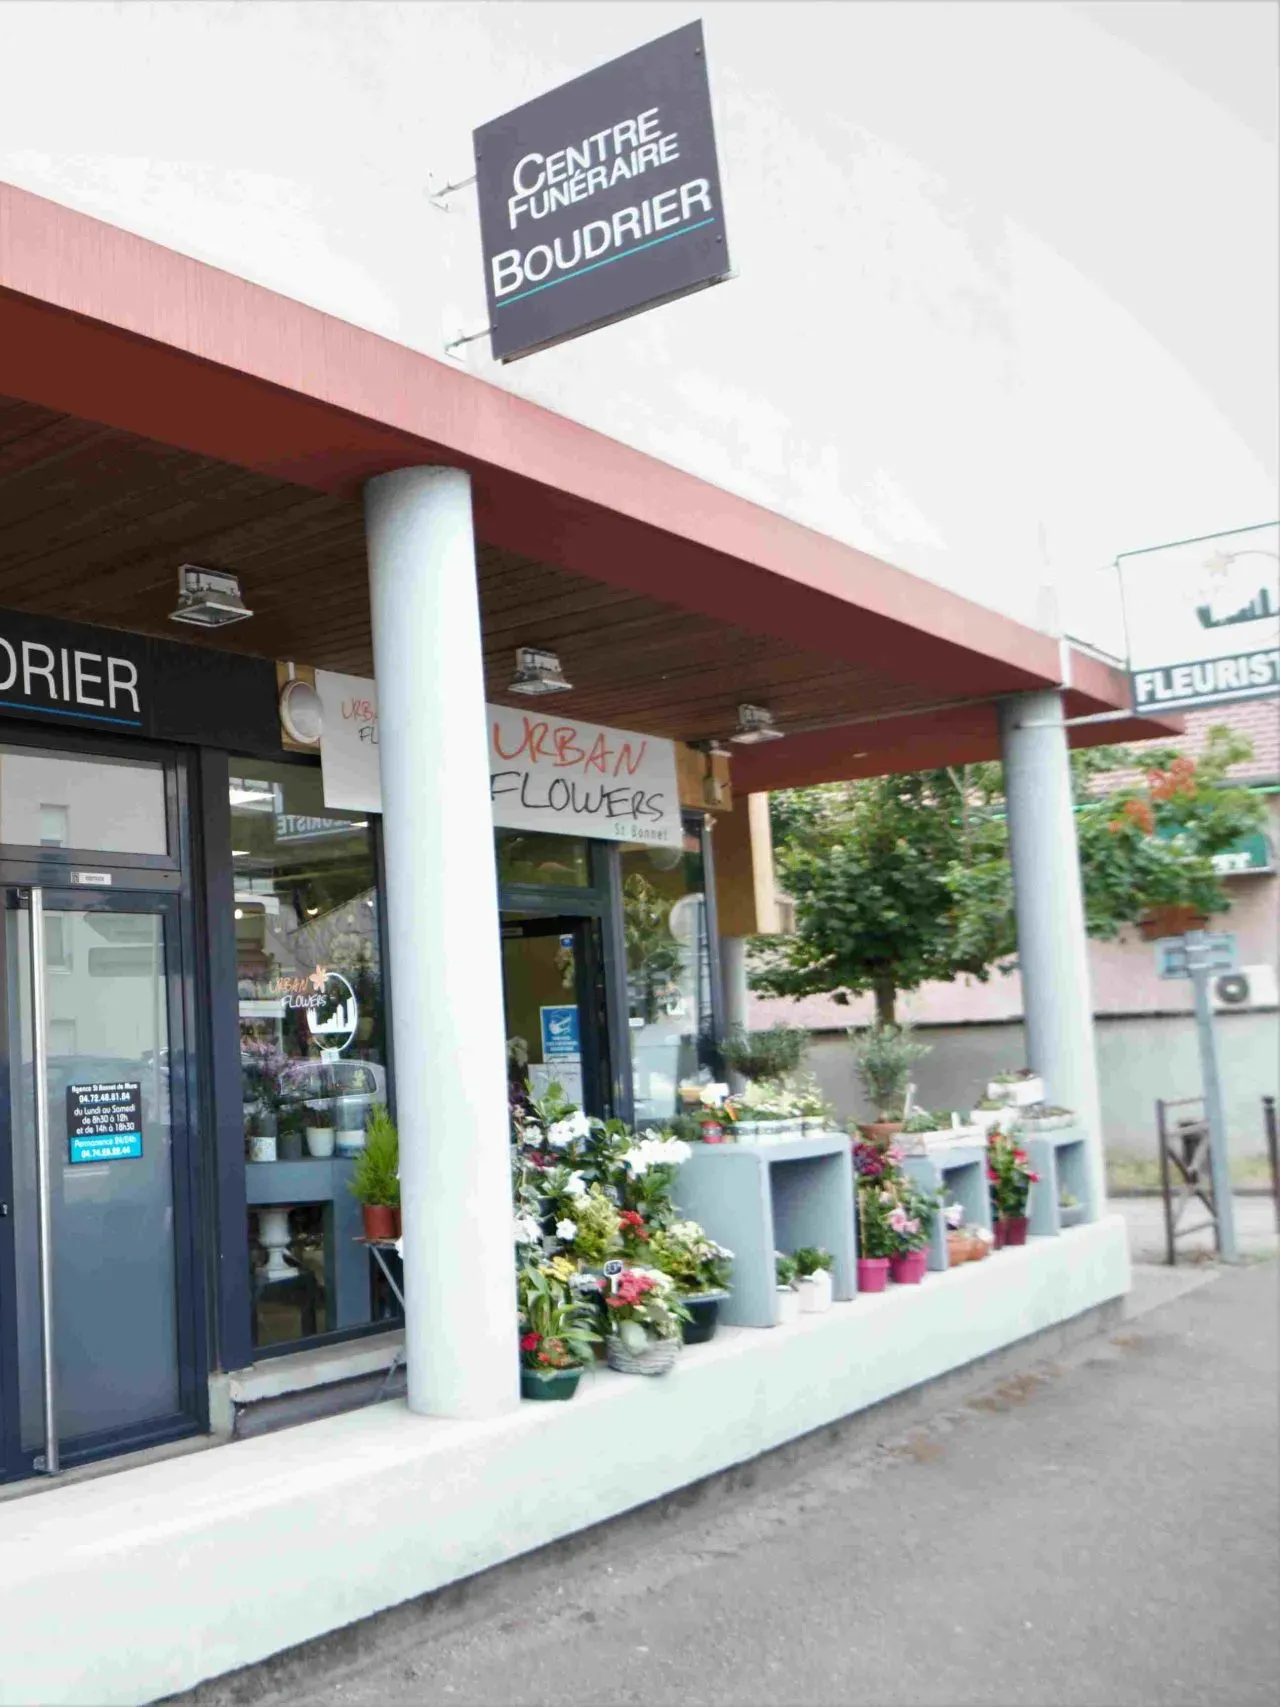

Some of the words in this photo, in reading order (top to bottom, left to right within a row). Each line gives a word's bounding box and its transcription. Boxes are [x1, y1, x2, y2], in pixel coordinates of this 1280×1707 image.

[508, 132, 680, 230] FUNÉRAIRE
[513, 107, 662, 197] CENTRE
[492, 178, 712, 297] BOUDRIER
[341, 698, 380, 723] URB
[493, 716, 646, 775] URBAN
[491, 772, 664, 822] FLOWERS
[280, 995, 327, 1008] FLOWERS
